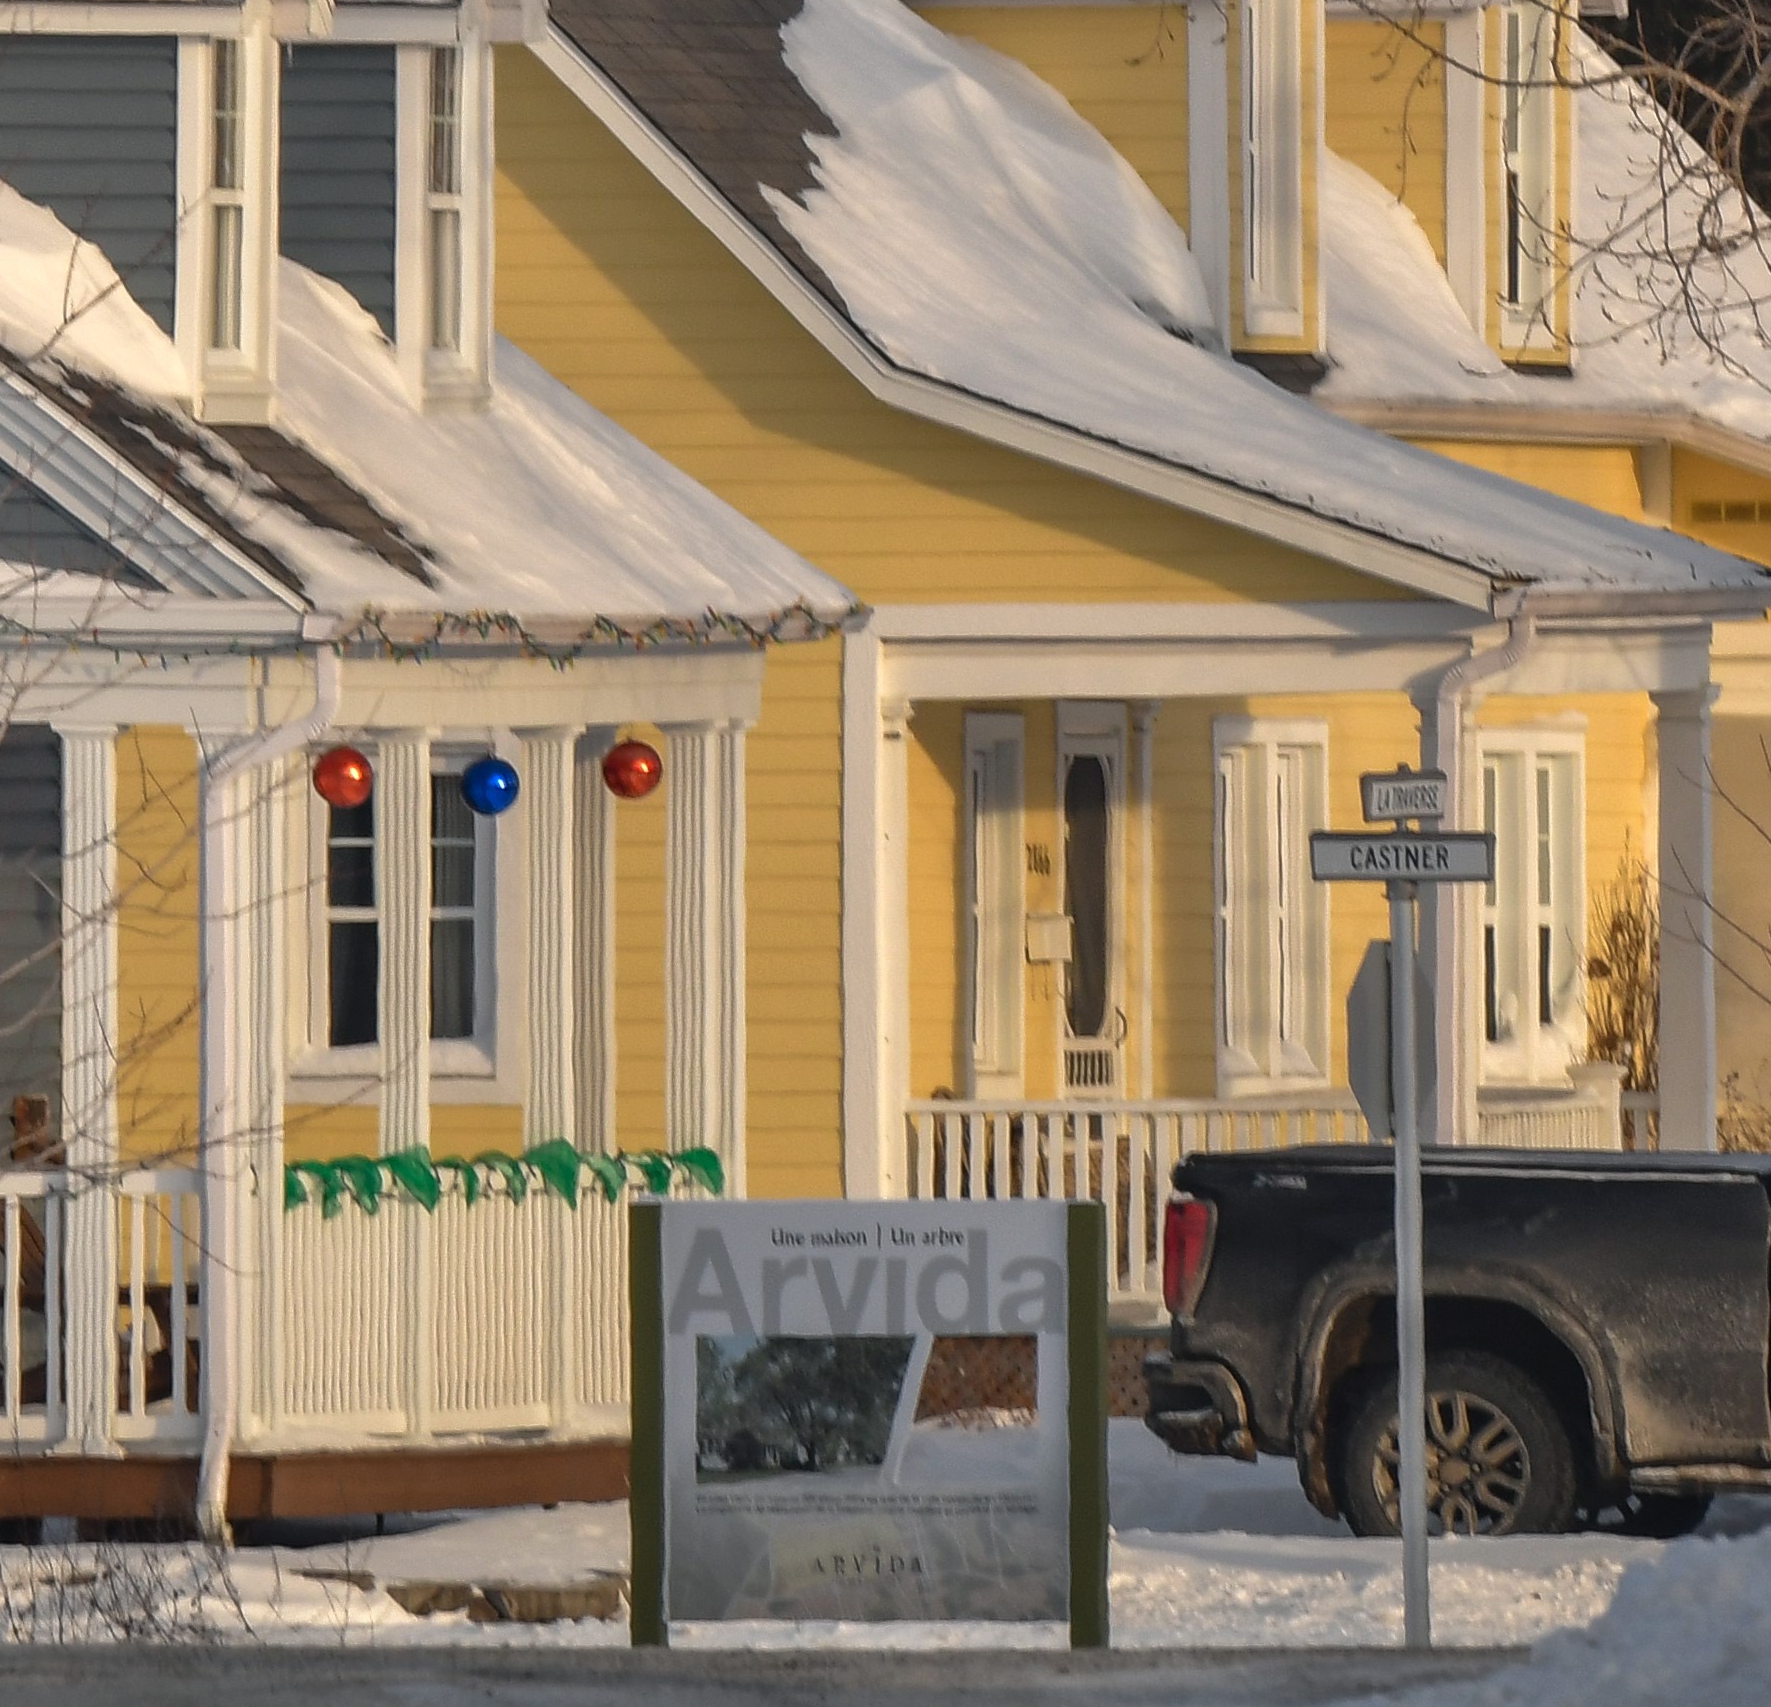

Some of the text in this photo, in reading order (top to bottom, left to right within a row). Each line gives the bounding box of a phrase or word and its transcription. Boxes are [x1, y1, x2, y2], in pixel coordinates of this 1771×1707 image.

[1350, 844, 1449, 870] CASTNER
[771, 1226, 964, 1247] Une maison Un arbre
[668, 1226, 1067, 1338] Arvida
